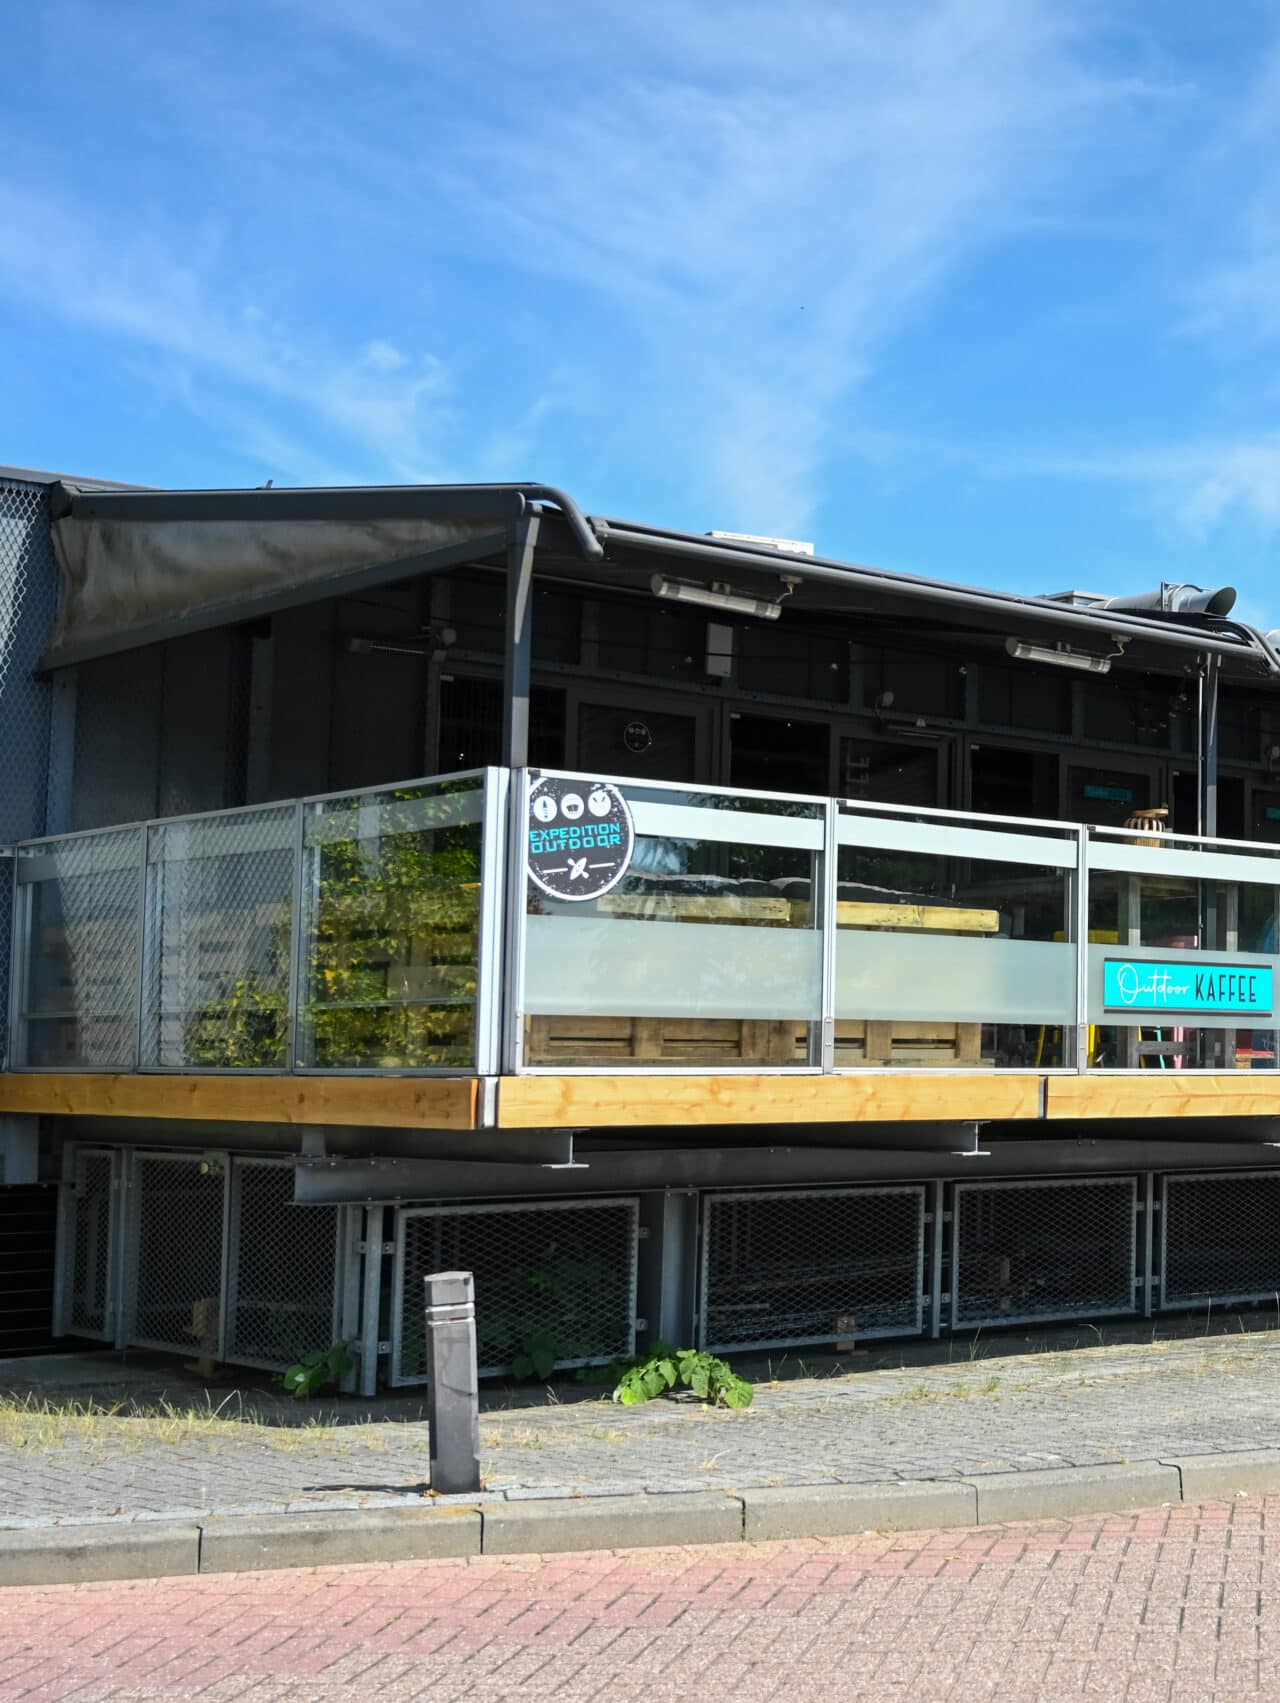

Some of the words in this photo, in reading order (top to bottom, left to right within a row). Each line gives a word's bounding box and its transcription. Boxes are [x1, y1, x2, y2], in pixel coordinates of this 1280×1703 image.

[529, 823, 621, 842] EXPEDITION
[531, 834, 621, 854] OUTDOOR
[1117, 964, 1191, 1005] Outdoor
[1195, 971, 1257, 1003] KAFFEE
